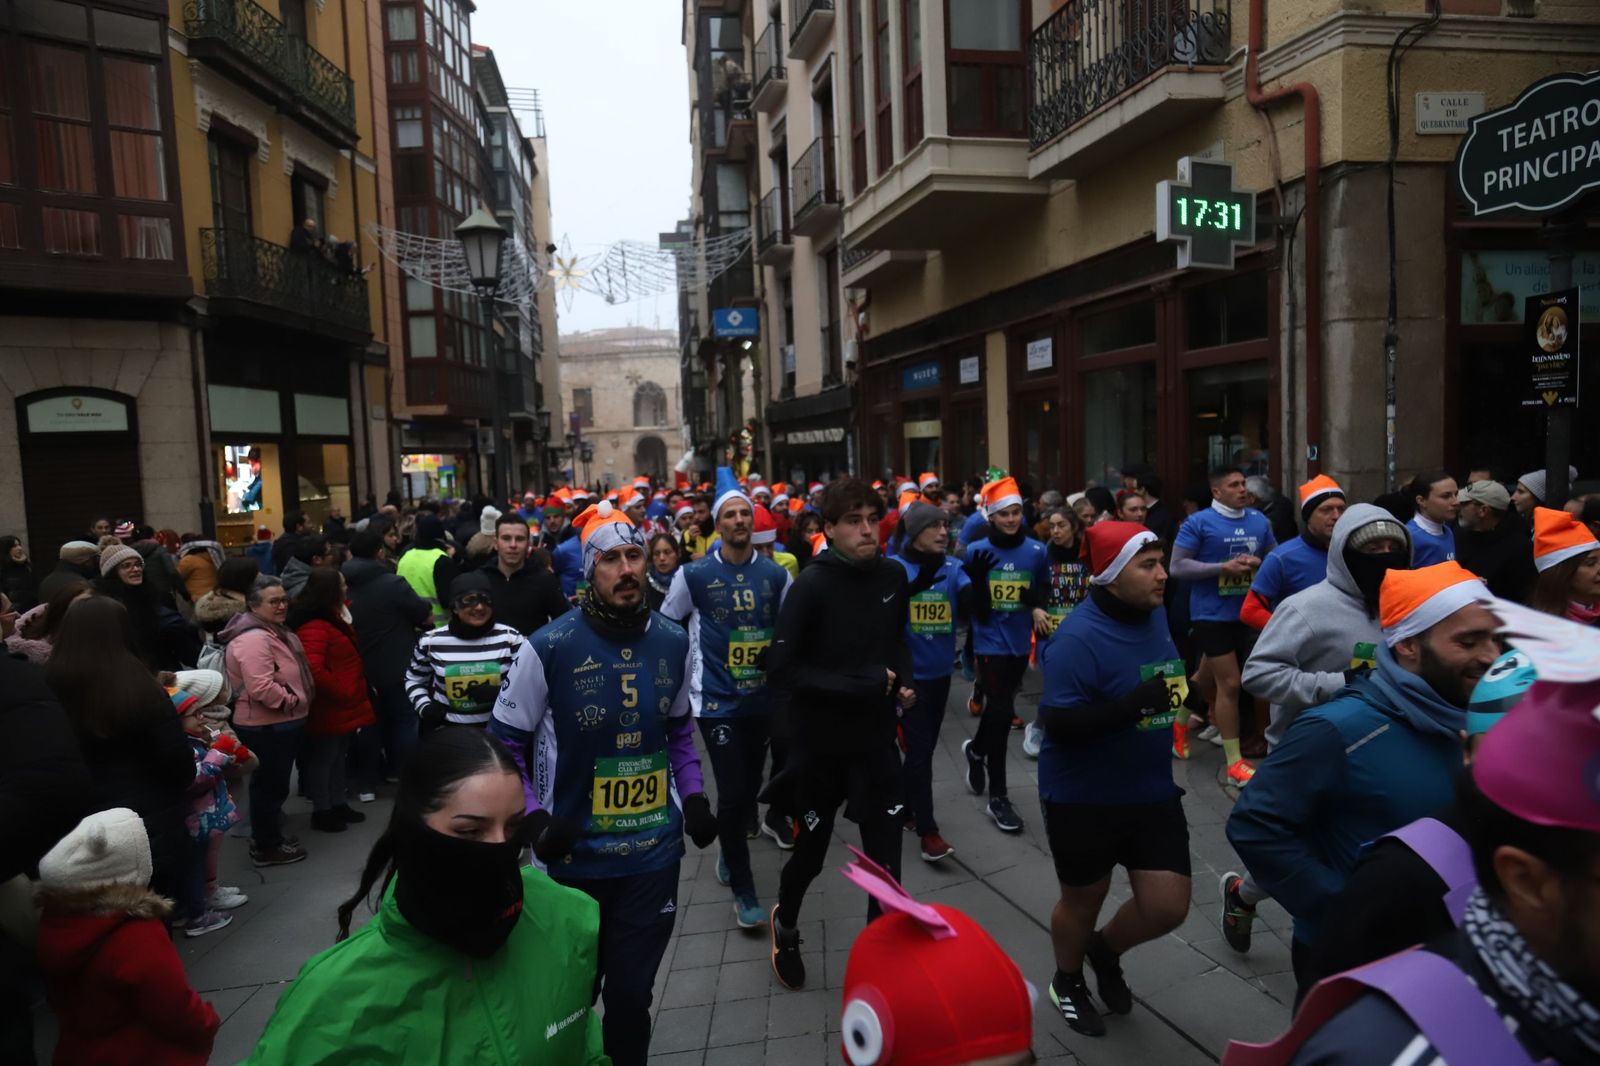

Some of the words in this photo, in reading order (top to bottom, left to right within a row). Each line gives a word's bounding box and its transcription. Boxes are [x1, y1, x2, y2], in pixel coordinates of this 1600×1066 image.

[1440, 98, 1469, 106] CALLE
[1421, 119, 1468, 129] QUEBRANTAHU
[1497, 99, 1600, 152] TEATRO
[1484, 139, 1600, 195] PRINCIPA
[1177, 198, 1241, 230] 17:31
[1505, 263, 1522, 275] Un
[1524, 263, 1552, 276] aliad
[1003, 562, 1015, 571] 46
[732, 589, 756, 611] 19
[914, 603, 946, 620] 1192
[732, 645, 767, 666] 95
[620, 673, 639, 709] 5
[600, 775, 658, 808] 1029
[616, 819, 638, 827] CAJA
[639, 812, 664, 826] RURAL
